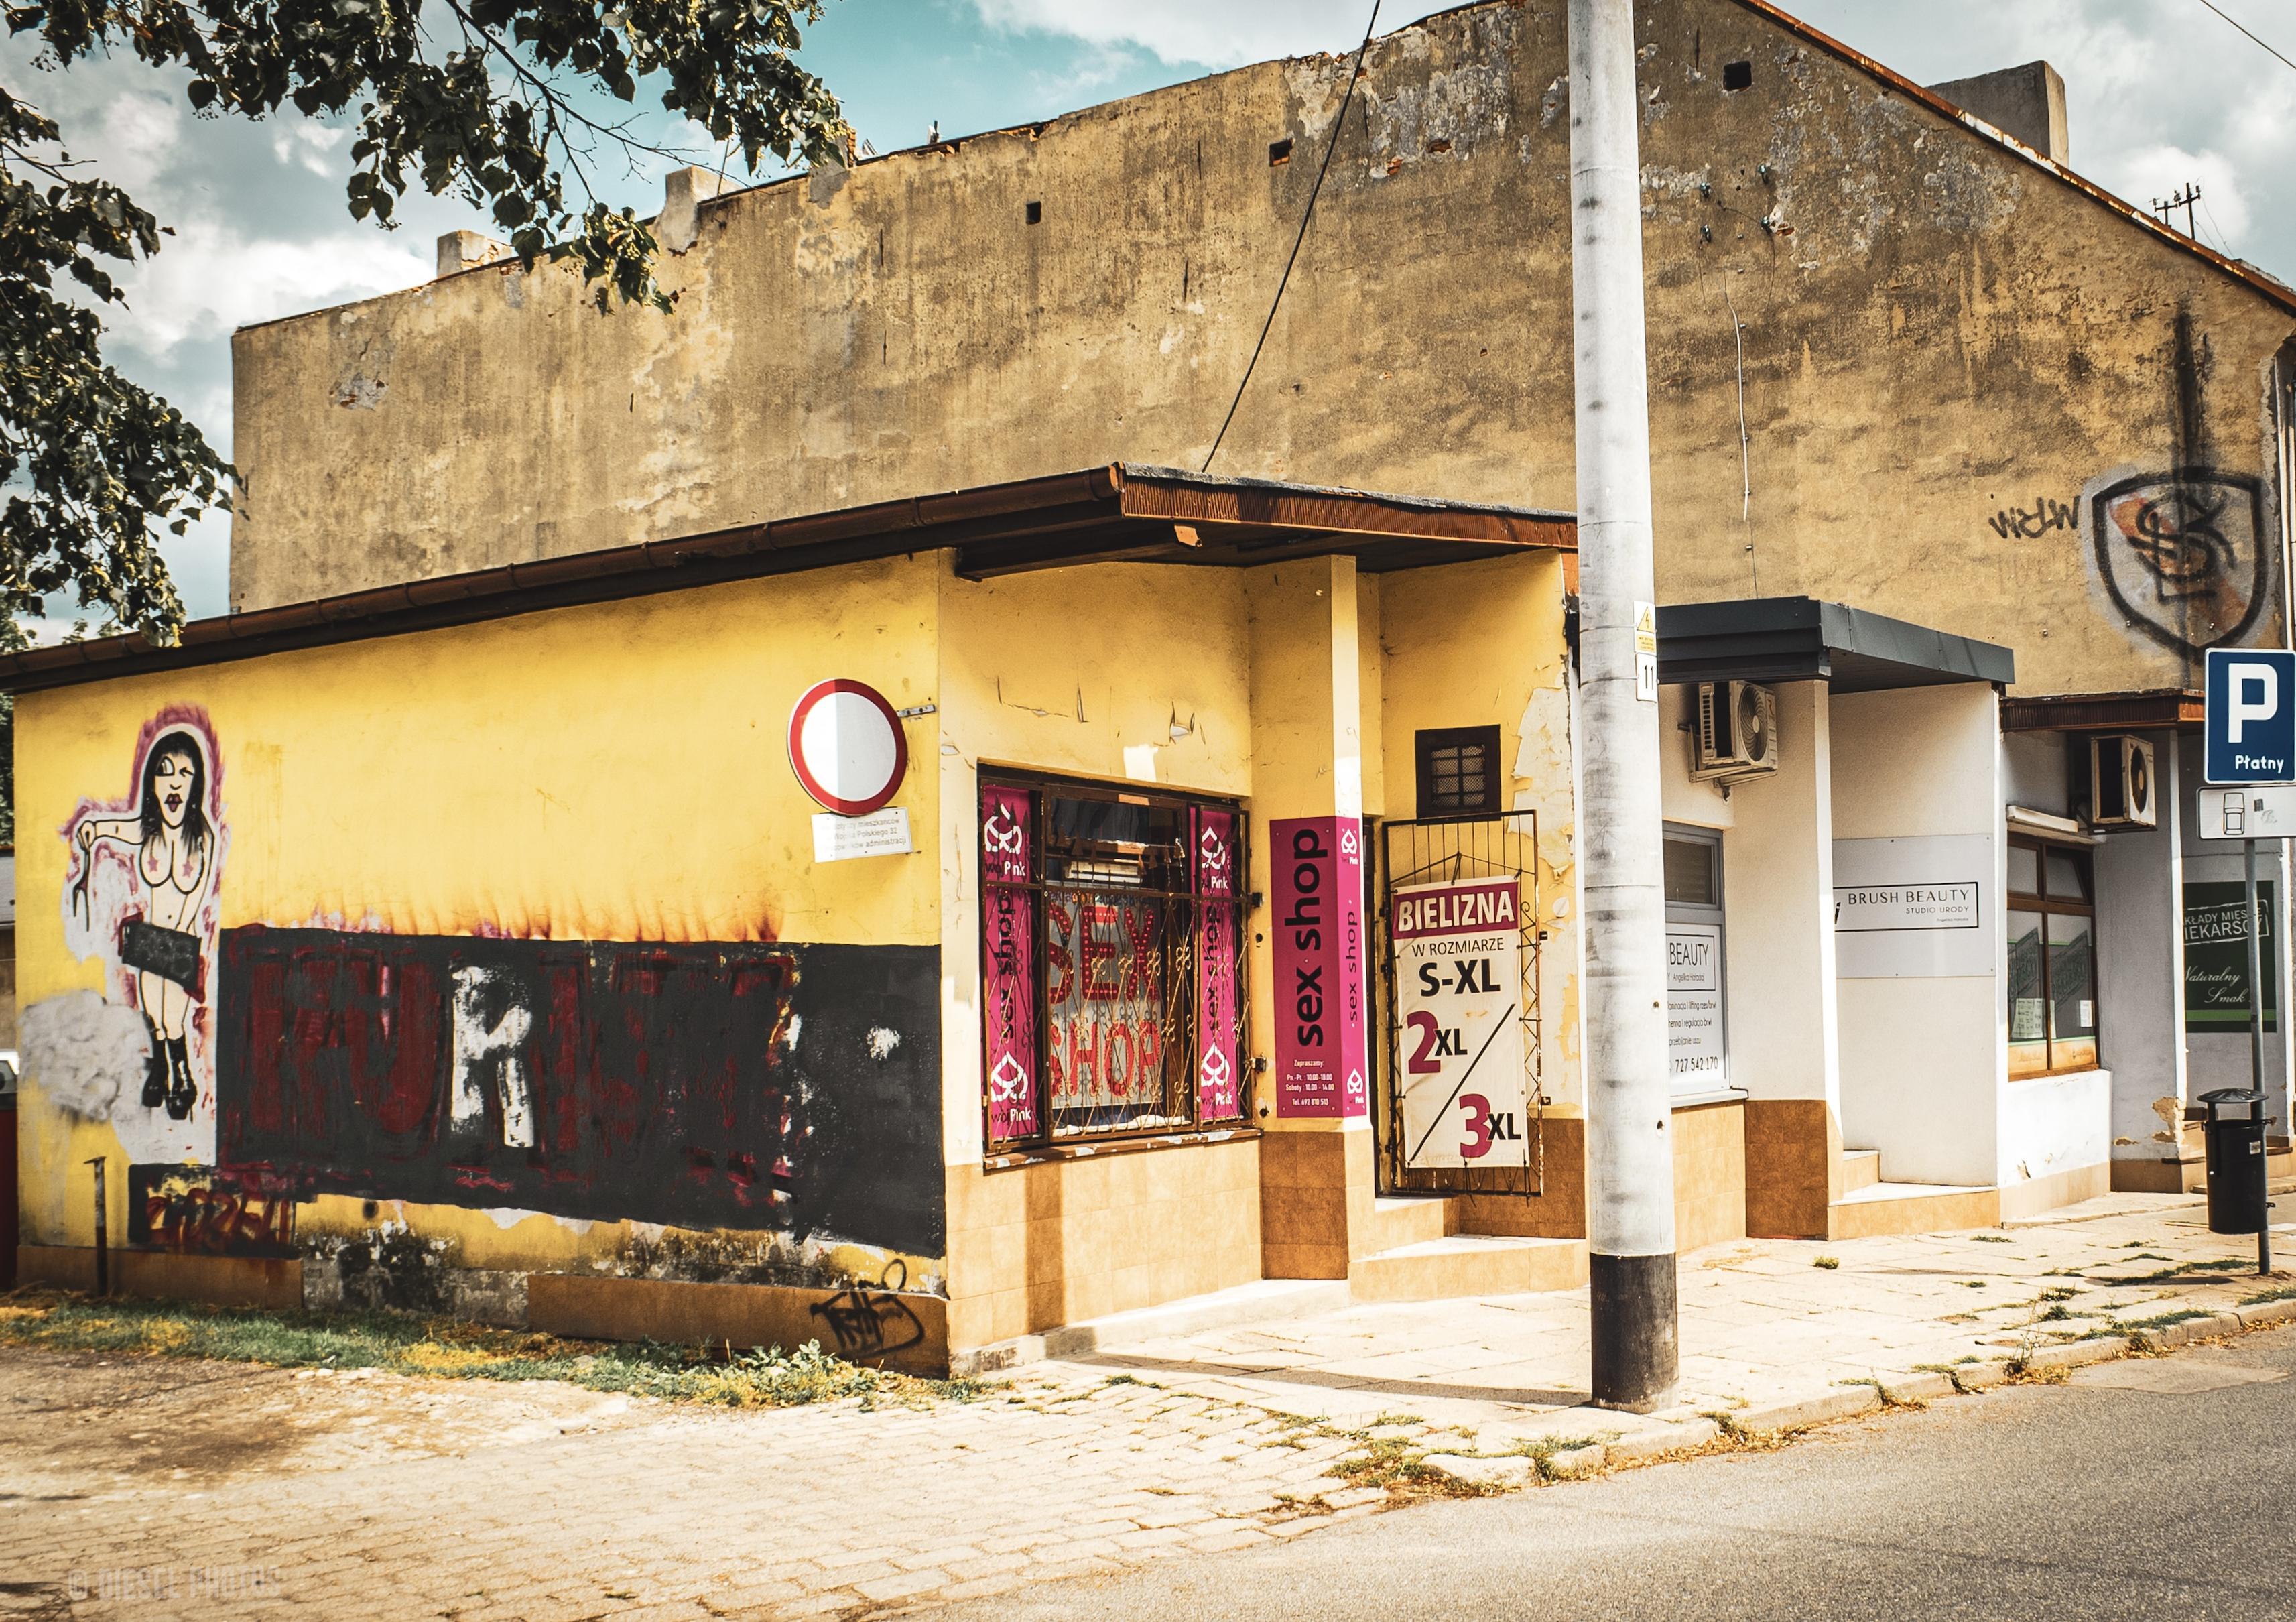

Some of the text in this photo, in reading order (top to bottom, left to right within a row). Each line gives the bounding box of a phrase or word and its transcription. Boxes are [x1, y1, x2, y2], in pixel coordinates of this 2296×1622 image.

[1644, 664, 1654, 690] 11
[2228, 663, 2278, 743] P
[2235, 755, 2284, 774] Płatny
[1004, 861, 1025, 876] Pnk
[1848, 889, 1970, 905] BRUSH BEAUTY
[1398, 890, 1515, 932] BIELIZNA
[1905, 906, 1970, 914] STUDIO URODY
[2185, 912, 2218, 925] KŁADY
[1285, 828, 1328, 1047] sex shop
[1412, 937, 1505, 958] W ROZMIARZE
[1669, 942, 1709, 966] BEAUTY
[1346, 912, 1358, 1022] sex shop
[2185, 965, 2242, 987] Naturalny
[1419, 958, 1501, 997] S-XL
[2203, 987, 2250, 1003] Smak
[1293, 1059, 1325, 1068] Zapraszamy:
[1675, 1056, 1719, 1073] 727 542 170
[1285, 1084, 1302, 1093] Soboty
[1322, 1083, 1335, 1091] 14.00
[1292, 1098, 1301, 1106] Tel.
[1301, 1098, 1310, 1106] 692
[1320, 1098, 1329, 1106] 513
[1010, 1106, 1031, 1123] Pink
